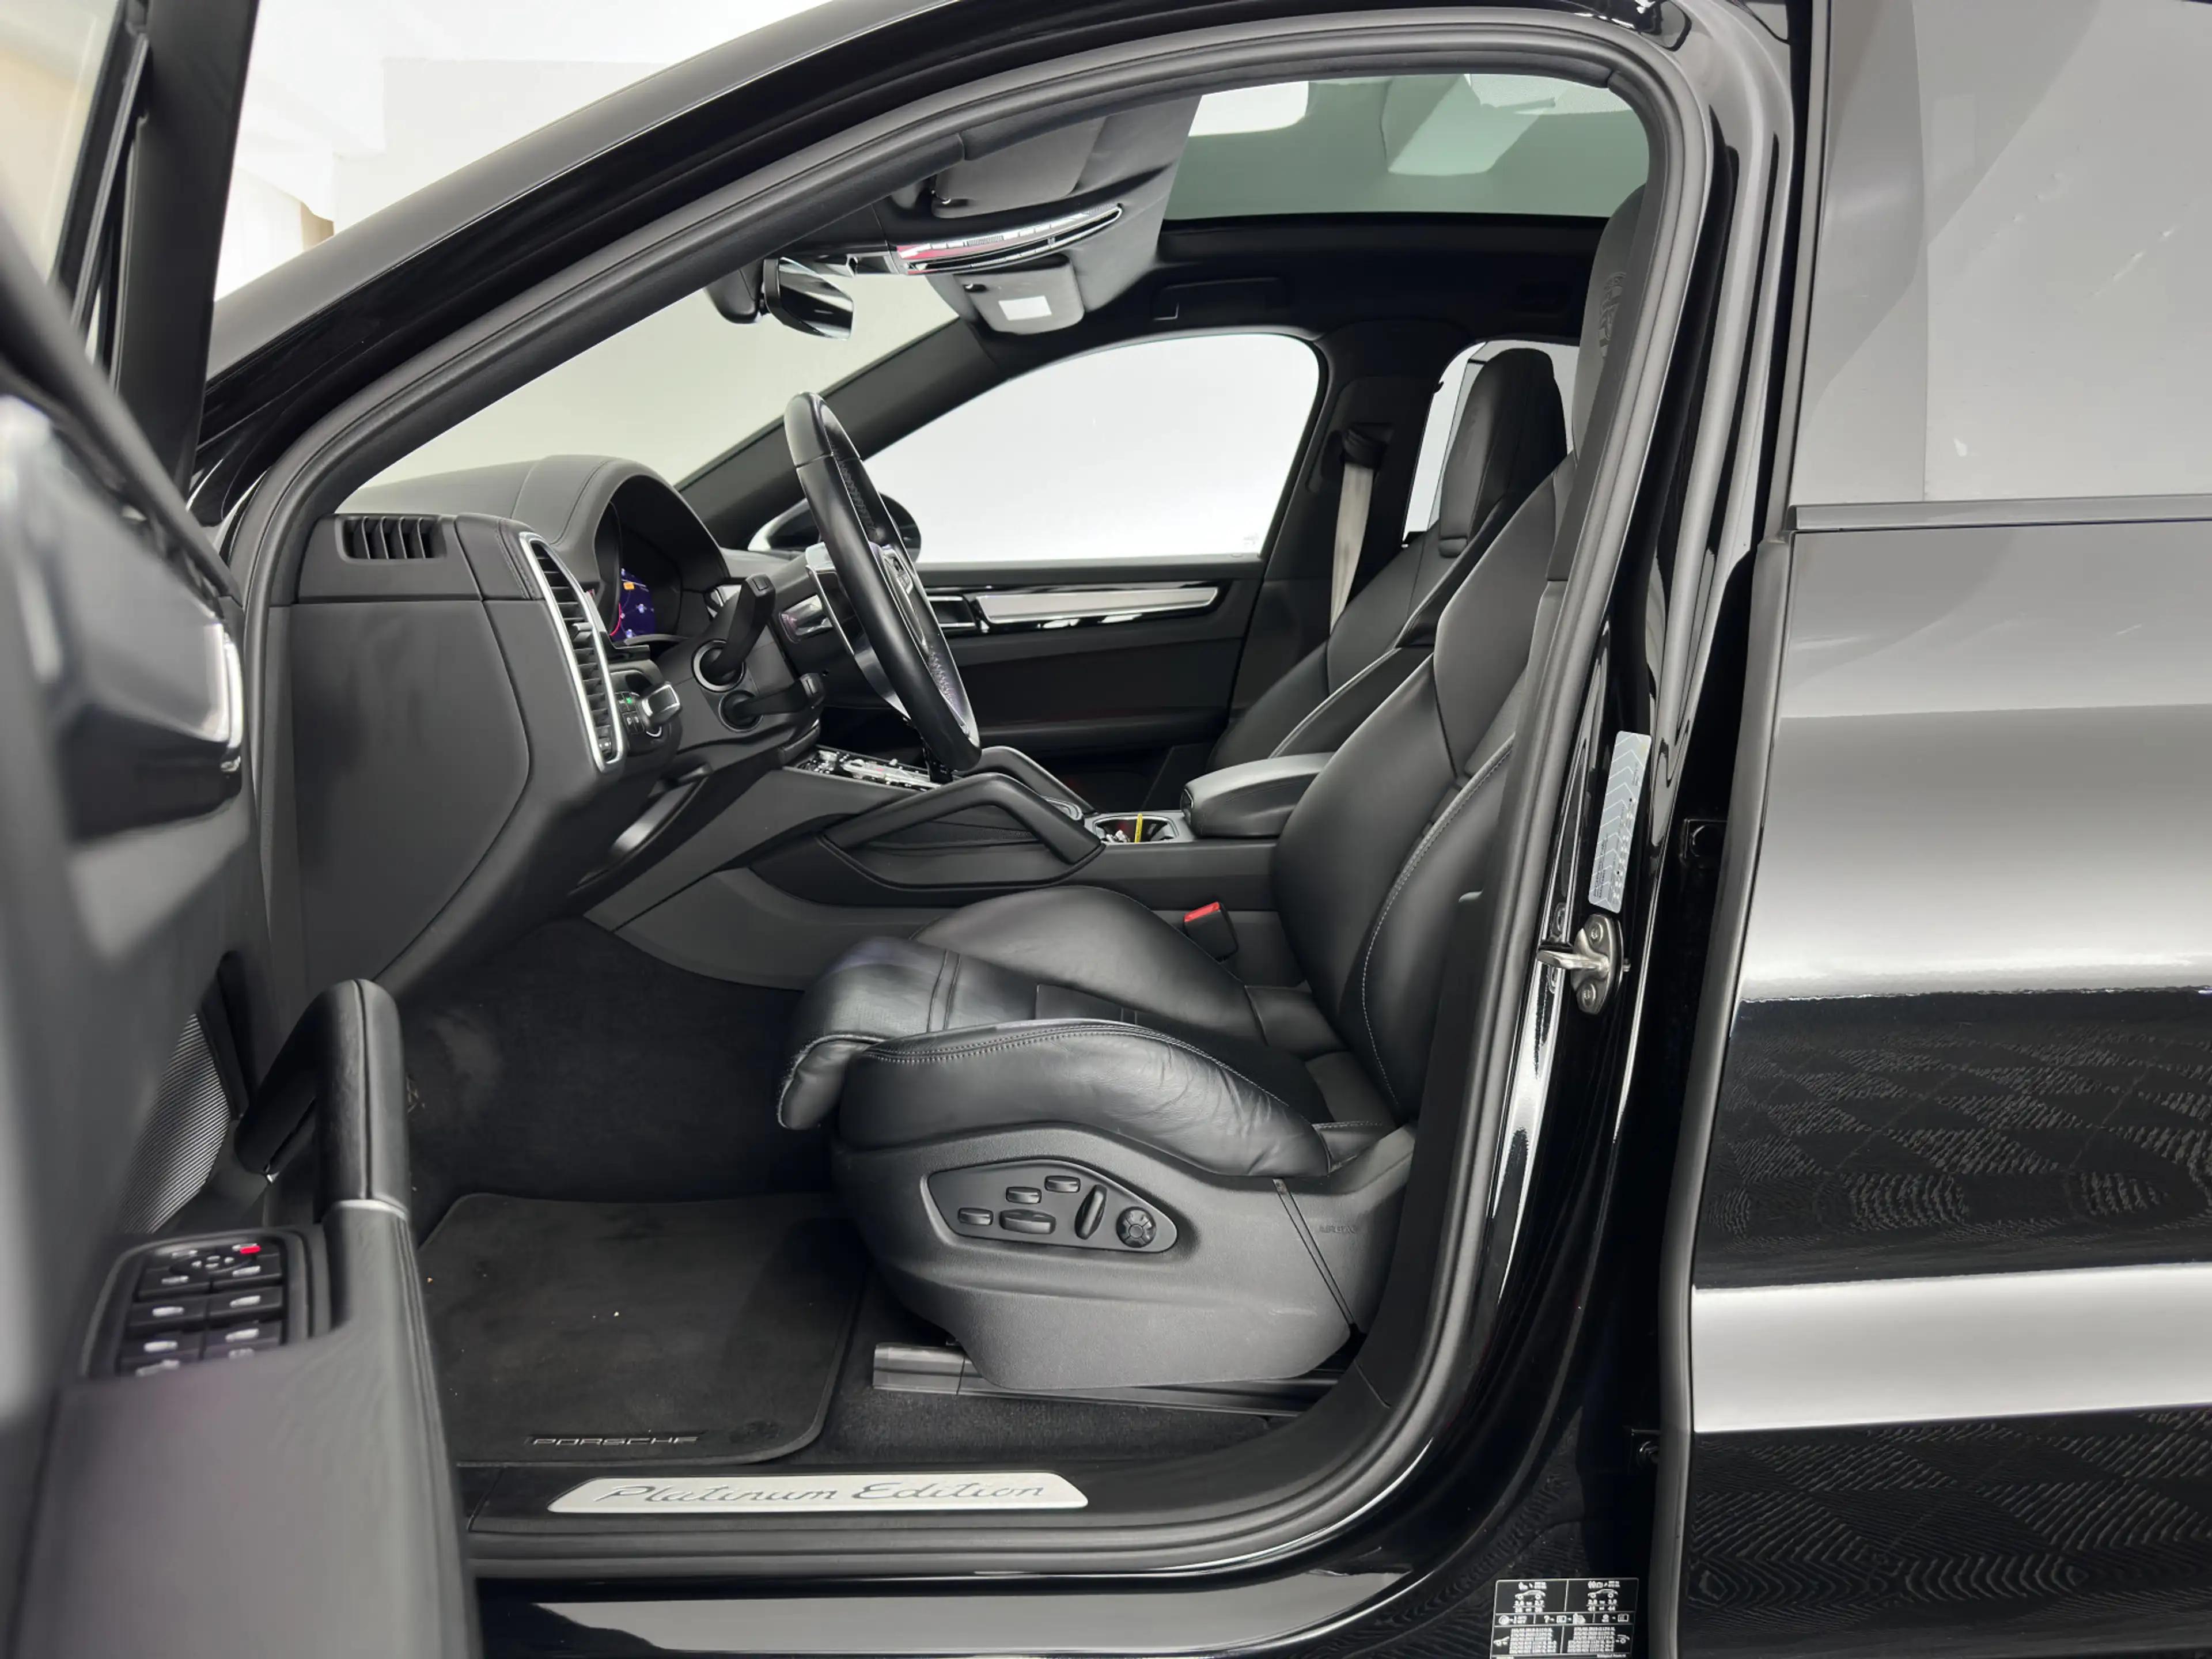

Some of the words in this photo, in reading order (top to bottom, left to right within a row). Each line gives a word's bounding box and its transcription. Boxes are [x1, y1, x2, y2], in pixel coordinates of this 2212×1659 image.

[532, 1436, 699, 1446] PORSCHE
[593, 1484, 838, 1502] Platinum
[851, 1482, 1044, 1499] Edition
